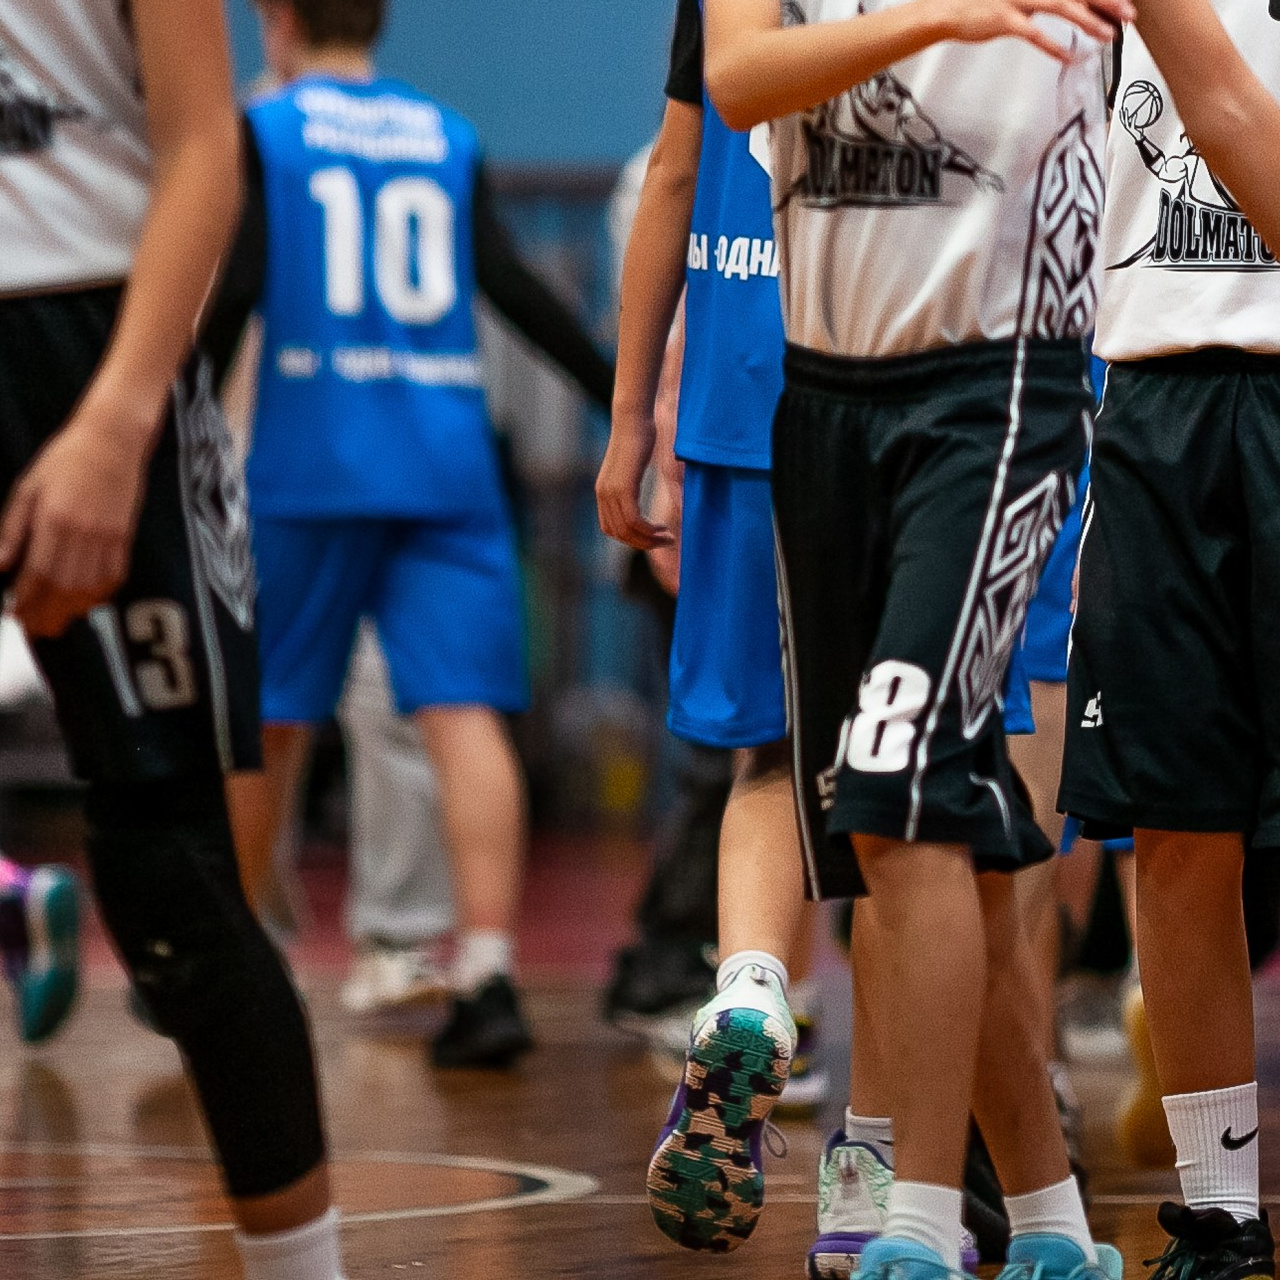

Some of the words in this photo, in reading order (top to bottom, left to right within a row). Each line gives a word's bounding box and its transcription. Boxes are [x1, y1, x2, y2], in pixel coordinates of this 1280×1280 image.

[309, 168, 456, 324] 10
[88, 599, 197, 718] 13
[834, 659, 931, 772] 8
